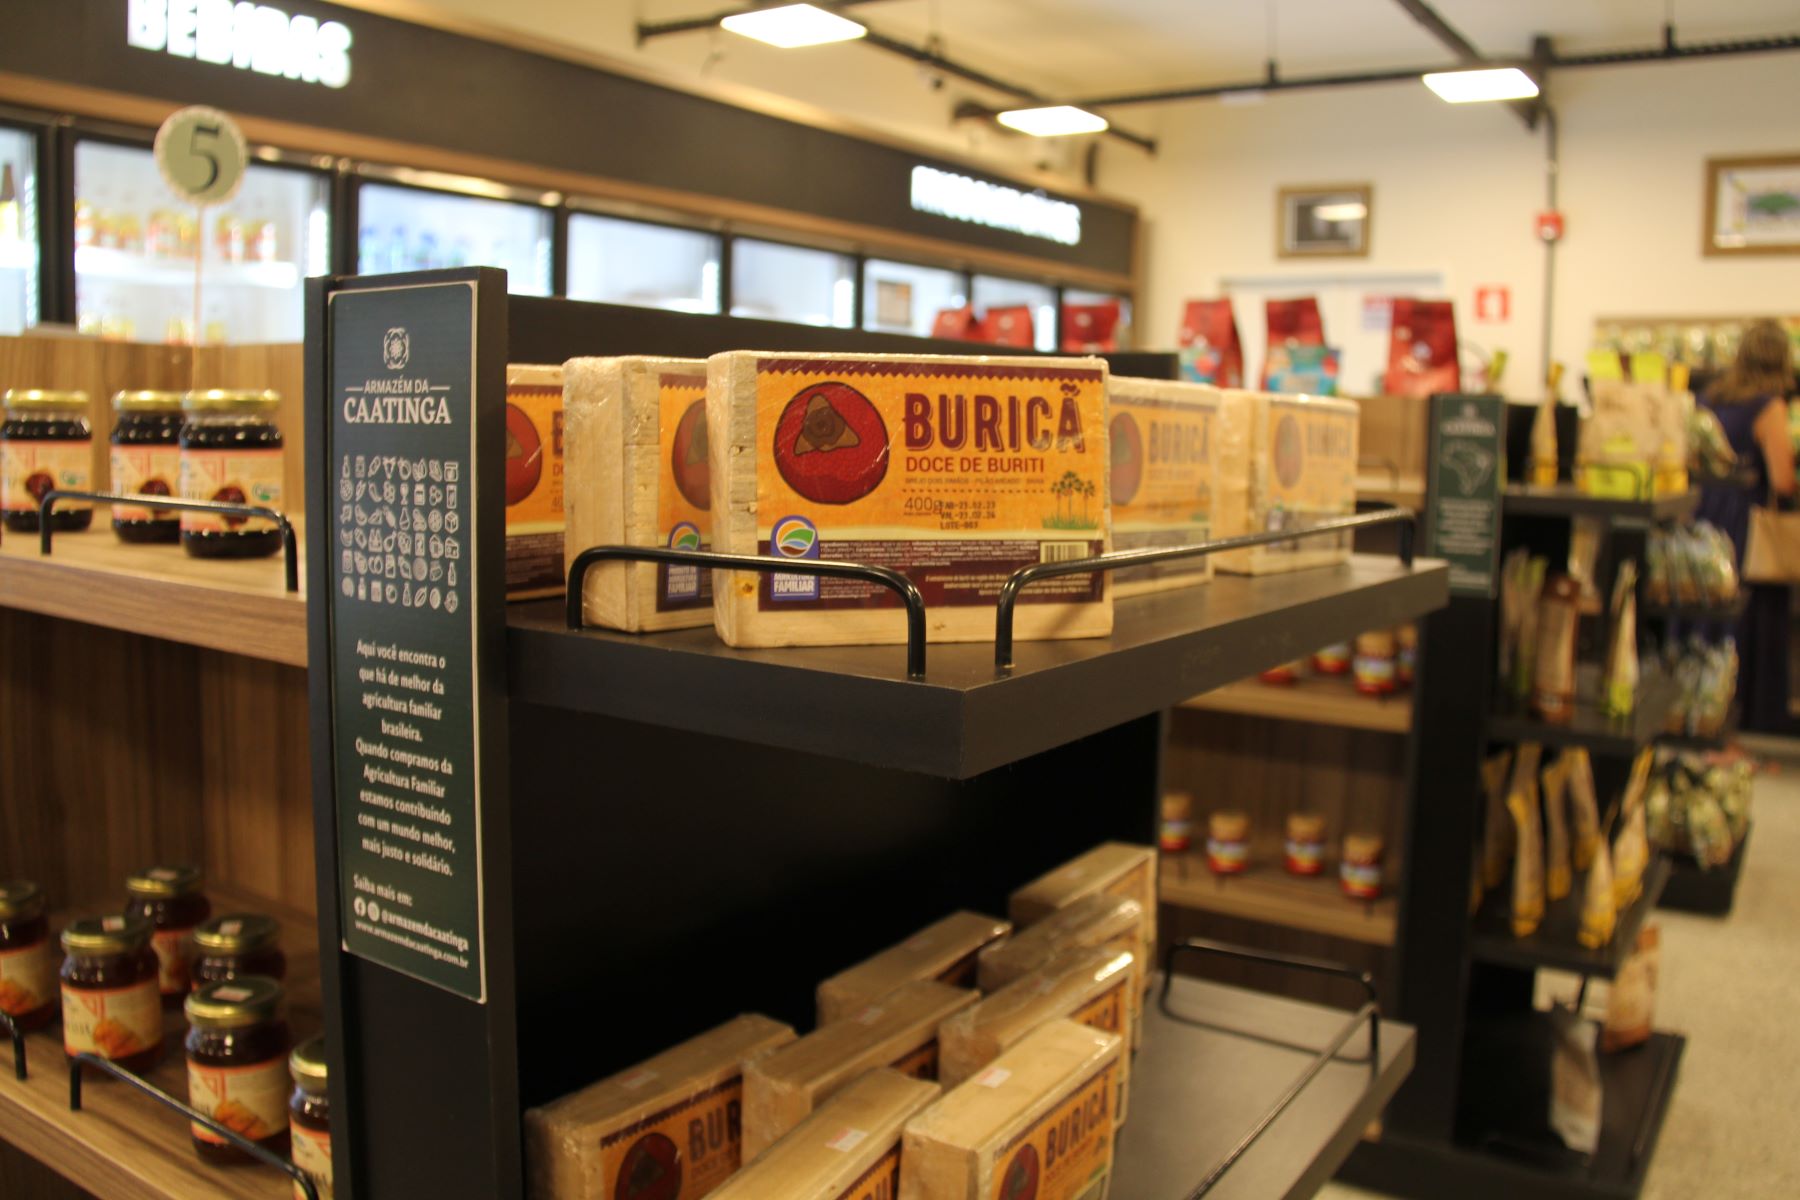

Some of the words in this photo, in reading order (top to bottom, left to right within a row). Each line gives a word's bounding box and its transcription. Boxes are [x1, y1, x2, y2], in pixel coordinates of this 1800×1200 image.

[189, 122, 222, 194] 5
[364, 374, 413, 394] ARMAZÉM
[414, 379, 429, 393] DA
[343, 396, 453, 425] CAATINGA
[905, 456, 954, 473] DOCE
[960, 456, 983, 473] DE
[987, 456, 1045, 473] BURITI
[904, 496, 942, 515] 400g
[774, 580, 814, 593] FAMILIAR
[357, 639, 376, 659] Aqui
[377, 644, 397, 661] você
[399, 650, 438, 668] encontra
[439, 657, 446, 669] o
[359, 667, 374, 682] que
[376, 667, 386, 684] há
[388, 670, 399, 686] de
[400, 674, 430, 692] melhor
[432, 679, 445, 695] da
[362, 692, 408, 713] agricultura
[409, 699, 442, 720] familiar
[381, 718, 423, 742] brasileira.
[355, 737, 388, 758] Quando
[390, 748, 439, 772] compramos
[441, 758, 453, 775] da
[363, 763, 410, 789] Agricultura
[411, 776, 445, 798] Familiar
[360, 790, 394, 810] estamos
[395, 800, 452, 826] contribuindo
[358, 812, 375, 828] com
[376, 819, 390, 832] um
[391, 823, 421, 842] mundo
[362, 838, 381, 854] mais
[381, 840, 403, 860] justo
[405, 851, 411, 863] e
[412, 852, 453, 876] solidário.
[353, 874, 376, 894] Saiba
[377, 884, 396, 901] mais
[688, 1098, 742, 1164] BUR
